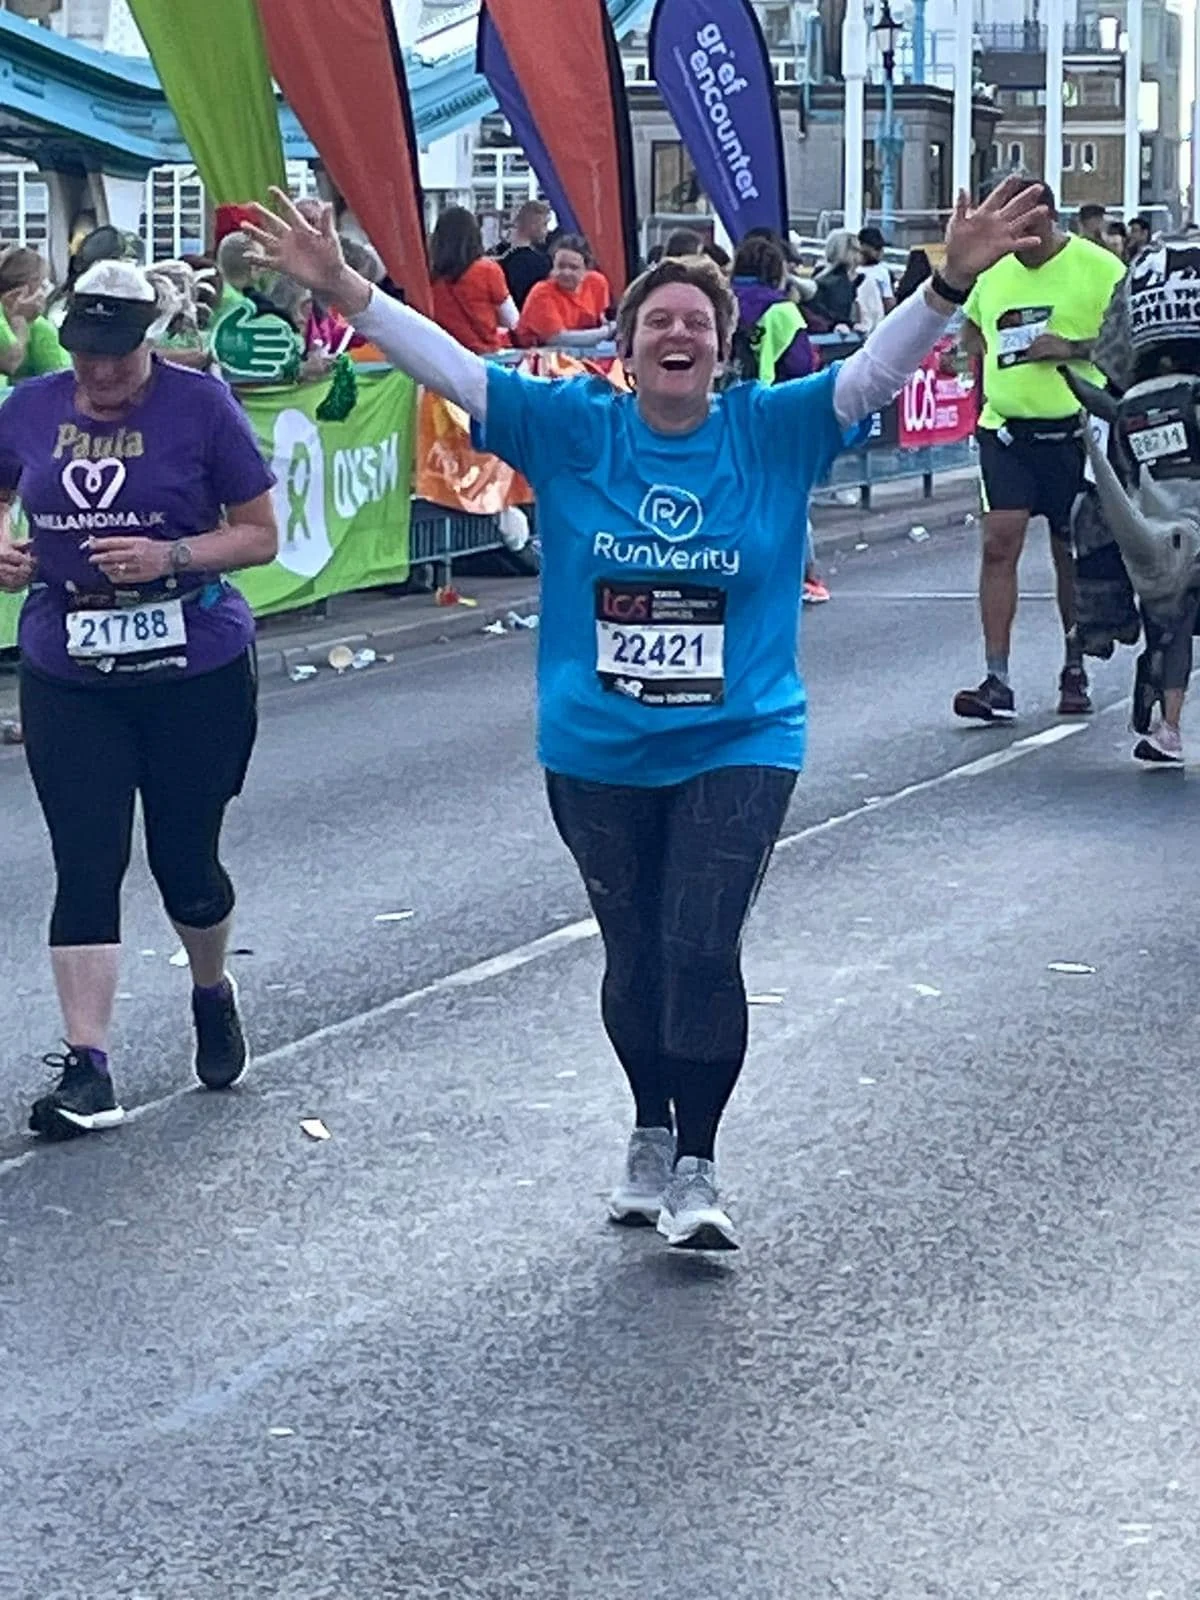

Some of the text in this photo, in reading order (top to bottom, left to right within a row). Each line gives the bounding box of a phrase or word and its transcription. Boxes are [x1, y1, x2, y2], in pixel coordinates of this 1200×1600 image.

[696, 23, 748, 96] gref
[689, 48, 759, 200] encounter
[1173, 288, 1200, 300] TH
[53, 423, 144, 459] Paula
[593, 531, 740, 576] RunVerity
[80, 608, 168, 647] 21788
[611, 630, 704, 667] 22421
